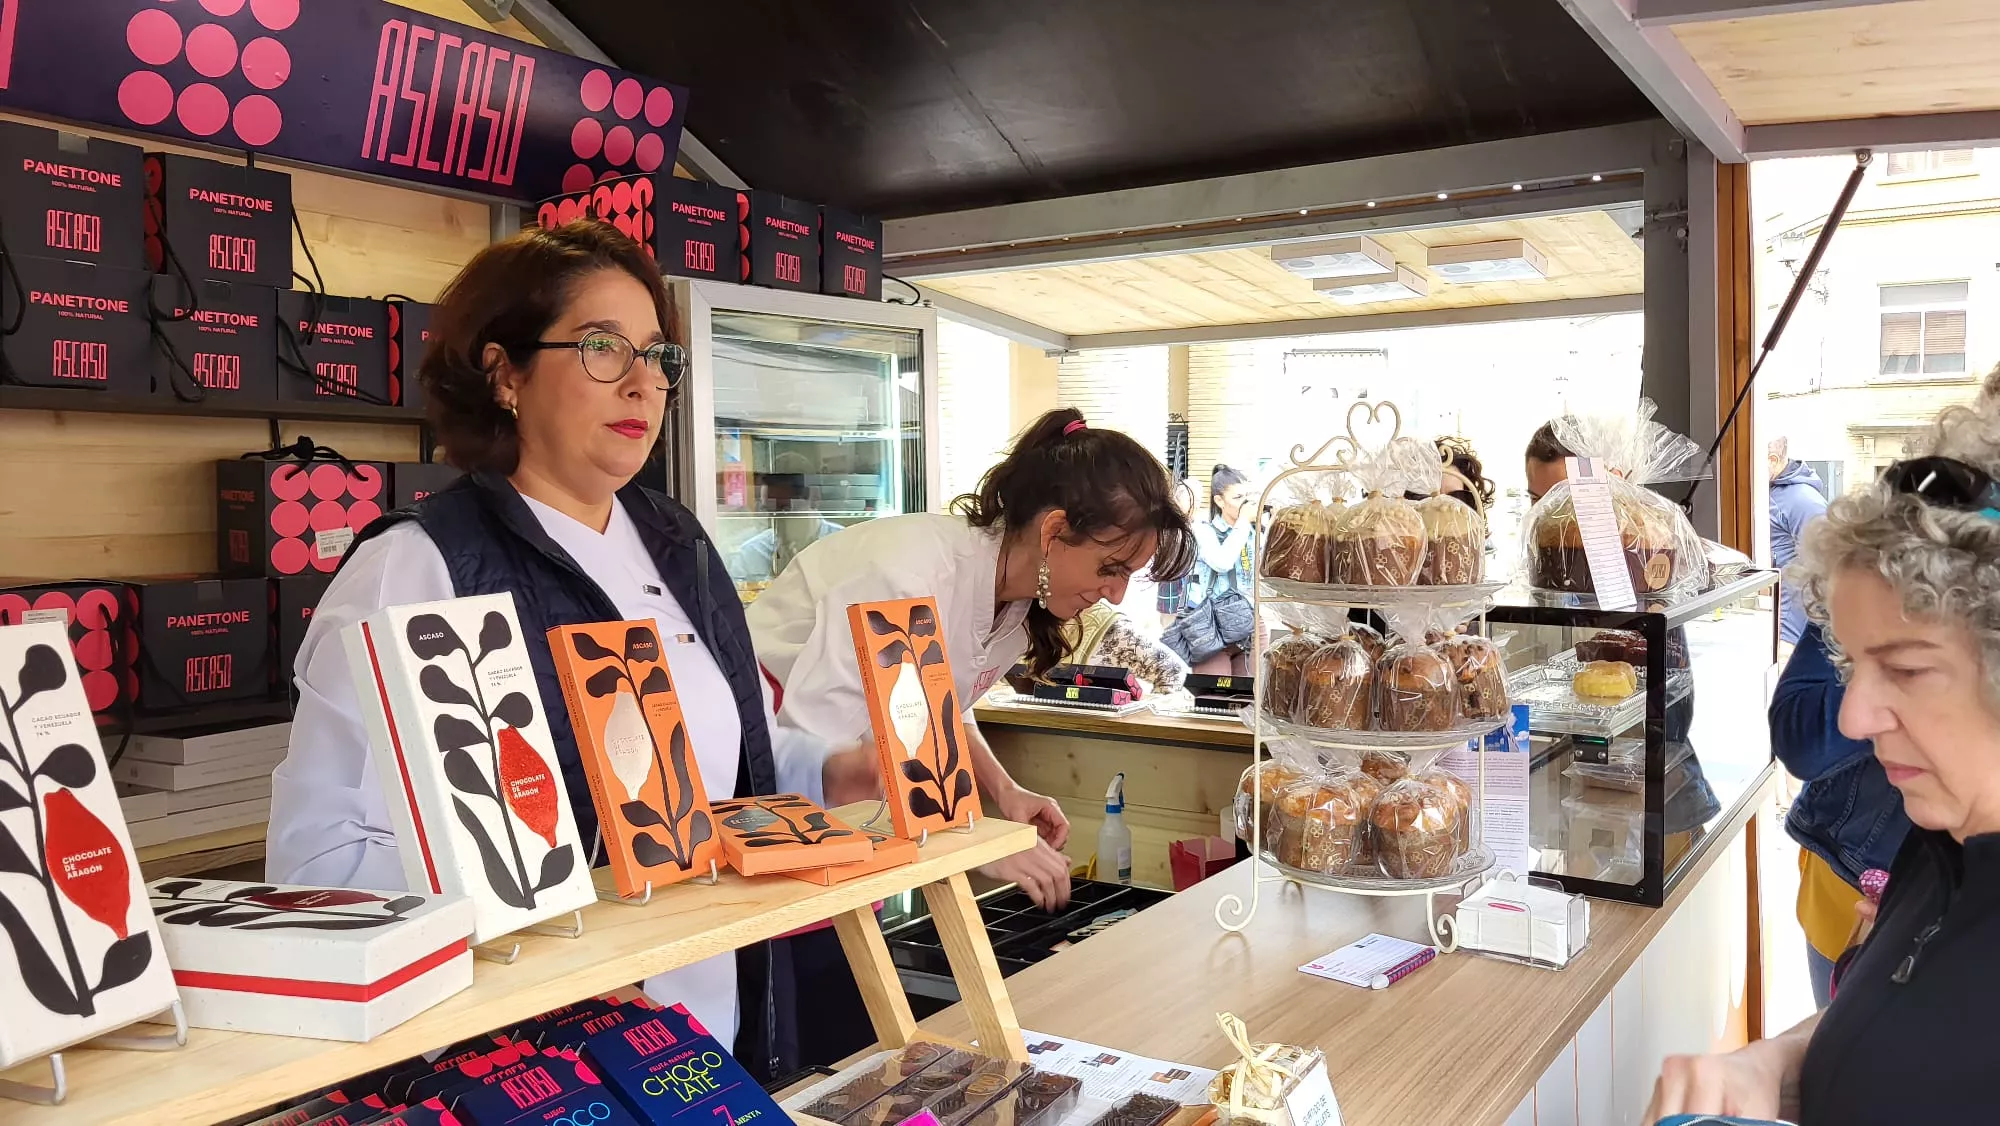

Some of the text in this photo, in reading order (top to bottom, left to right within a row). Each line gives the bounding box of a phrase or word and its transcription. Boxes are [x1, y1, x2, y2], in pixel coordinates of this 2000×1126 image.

[361, 18, 536, 186] ASCASO
[23, 158, 122, 187] PANETTONE
[68, 183, 97, 192] NATURAL
[189, 188, 273, 212] PANETTONE
[228, 209, 252, 218] NATURAL
[672, 202, 726, 221] PANETTONE
[46, 209, 101, 253] ASCASO
[765, 216, 810, 236] PANETTONE
[836, 231, 875, 250] PANETTONE
[209, 234, 256, 273] ASCASO
[685, 240, 715, 273] ASCASO
[775, 252, 801, 283] ASCASO
[844, 264, 866, 295] ASCASO
[30, 290, 129, 313] PANETTONE
[58, 310, 104, 320] 100% NATURAL
[334, 338, 356, 346] NATURAL
[53, 339, 108, 380] ASCASO
[193, 352, 240, 390] ASCASO
[167, 611, 250, 628] PANETTONE
[418, 631, 444, 641] ASCASO
[632, 642, 653, 650] ASCASO
[186, 654, 232, 693] ASCASO
[40, 720, 72, 728] VENEZUELA
[54, 711, 81, 720] ECUADOR
[510, 774, 546, 787] CHOCOLATE
[514, 787, 539, 800] ARAGÓN
[62, 846, 112, 866] CHOCOLATE
[64, 864, 76, 874] DE
[66, 864, 104, 880] ARAGÓN
[623, 1018, 678, 1057] ASCASO
[668, 1049, 696, 1064] NATURAL
[642, 1051, 722, 1096] CHOCO
[500, 1066, 562, 1109] ASCASO
[673, 1070, 721, 1102] LATE
[734, 1110, 762, 1126] MENTA
